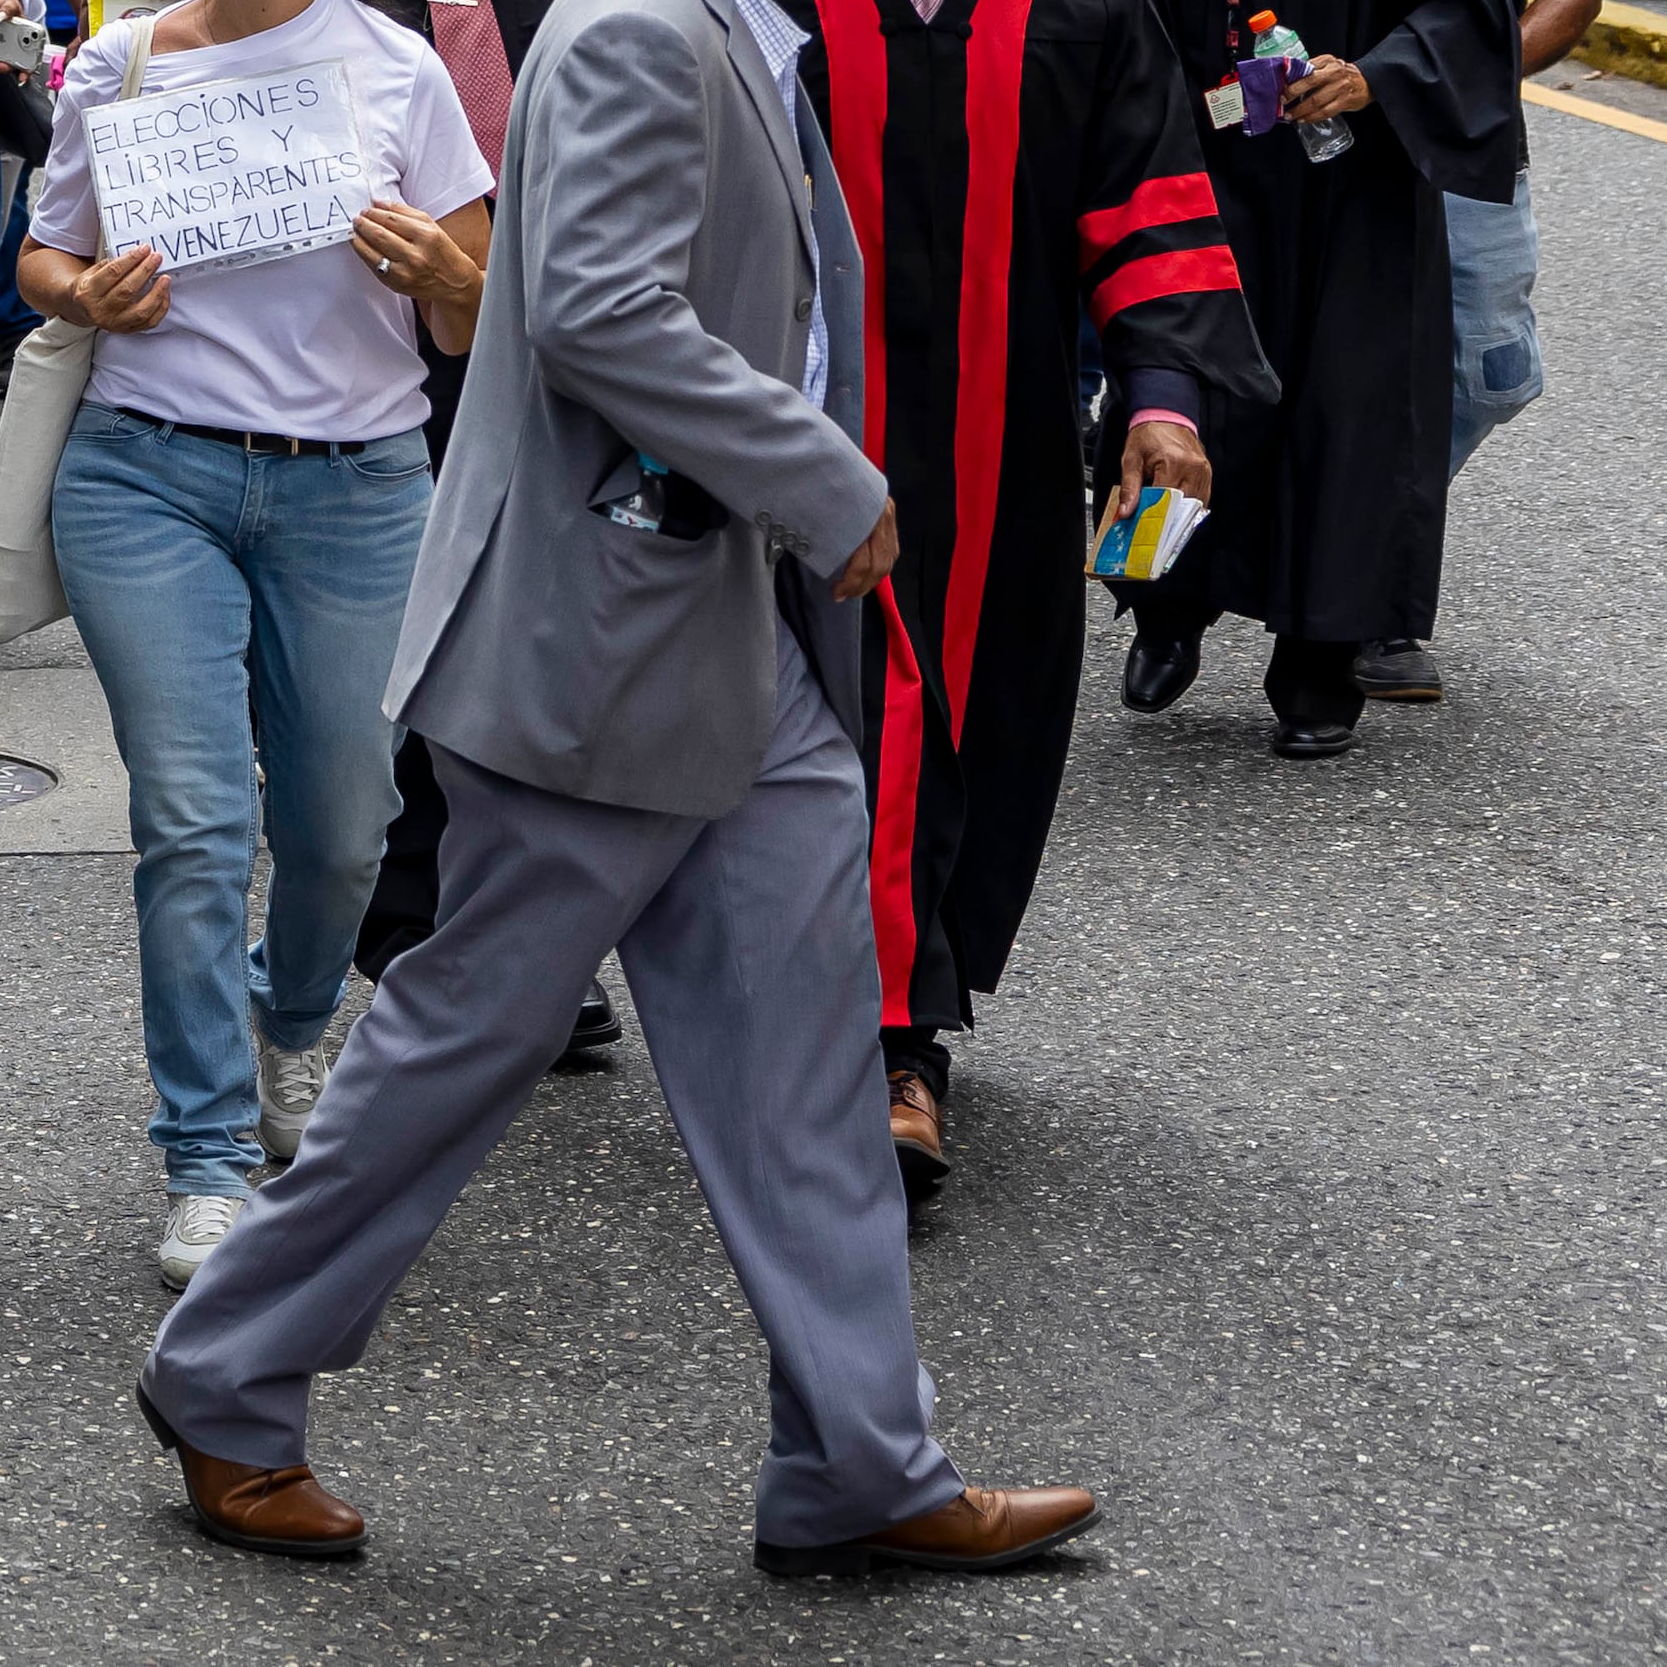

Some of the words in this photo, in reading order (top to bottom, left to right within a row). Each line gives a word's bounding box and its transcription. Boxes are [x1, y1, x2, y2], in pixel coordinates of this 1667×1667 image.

[92, 78, 319, 155] ELECCIONES
[104, 151, 362, 232] TRANSPARENTES
[105, 136, 239, 190] LIBRES
[271, 124, 293, 152] Y
[159, 195, 352, 262] VENEZUELA
